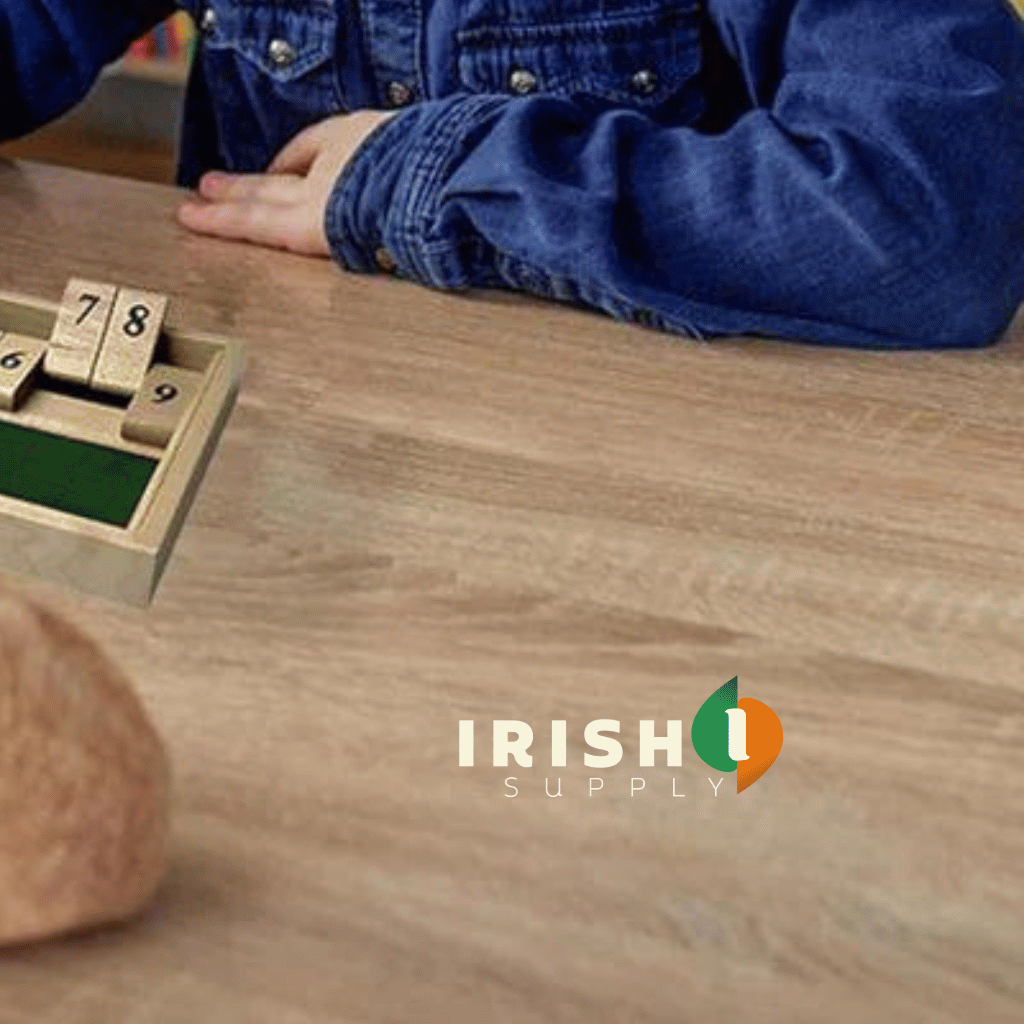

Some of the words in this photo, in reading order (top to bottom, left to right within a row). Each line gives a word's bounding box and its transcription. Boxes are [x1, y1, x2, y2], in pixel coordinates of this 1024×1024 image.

[76, 293, 101, 326] 7
[123, 304, 150, 337] 8
[0, 350, 27, 370] 6
[151, 383, 179, 403] 9
